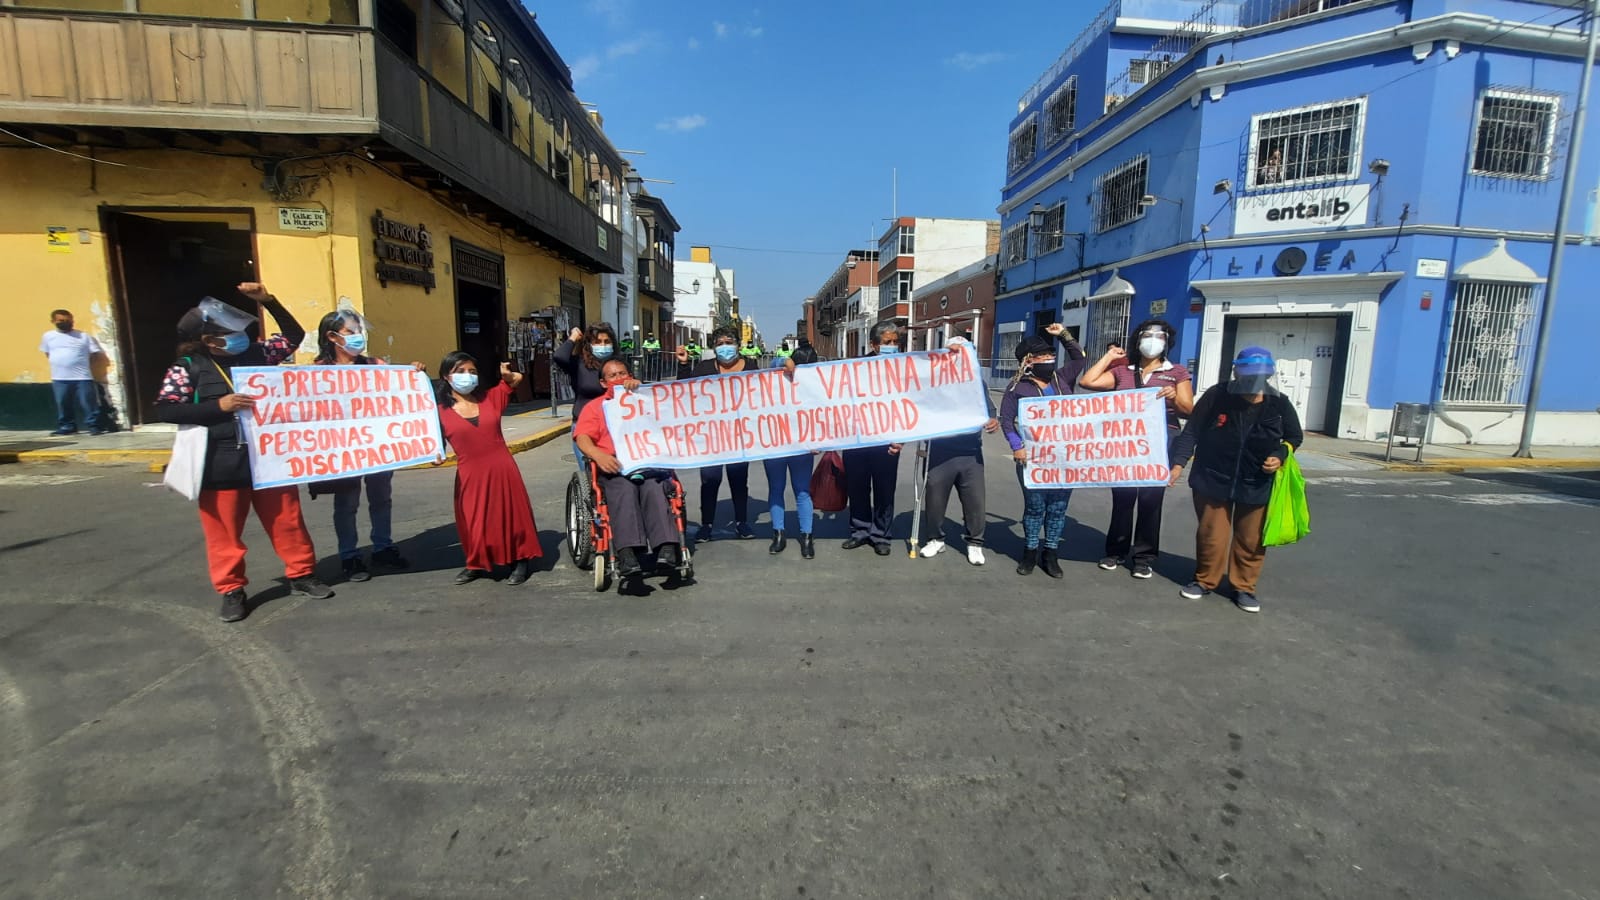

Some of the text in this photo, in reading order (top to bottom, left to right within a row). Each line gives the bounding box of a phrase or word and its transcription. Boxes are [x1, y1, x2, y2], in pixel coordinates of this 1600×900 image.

[1229, 247, 1356, 275] LIEA
[248, 369, 424, 400] Sr. PRESIDENTE
[652, 370, 800, 421] PRESIDENTE
[816, 356, 921, 400] VACUNA
[928, 346, 974, 388] PARA
[251, 392, 434, 427] VACUNA PARA LAS
[1027, 392, 1146, 420] Sr. PRESIDENTE
[259, 418, 428, 456] PERSONAS CON
[624, 398, 919, 460] LAS PERSONAS CON DISCAPACIDAD
[1030, 419, 1147, 442] VACUNA PARA
[287, 437, 437, 478] DISCAPACIDAD
[1031, 440, 1150, 464] LAS PERSONAS
[1031, 464, 1169, 484] CON DISCAPACIDAD
